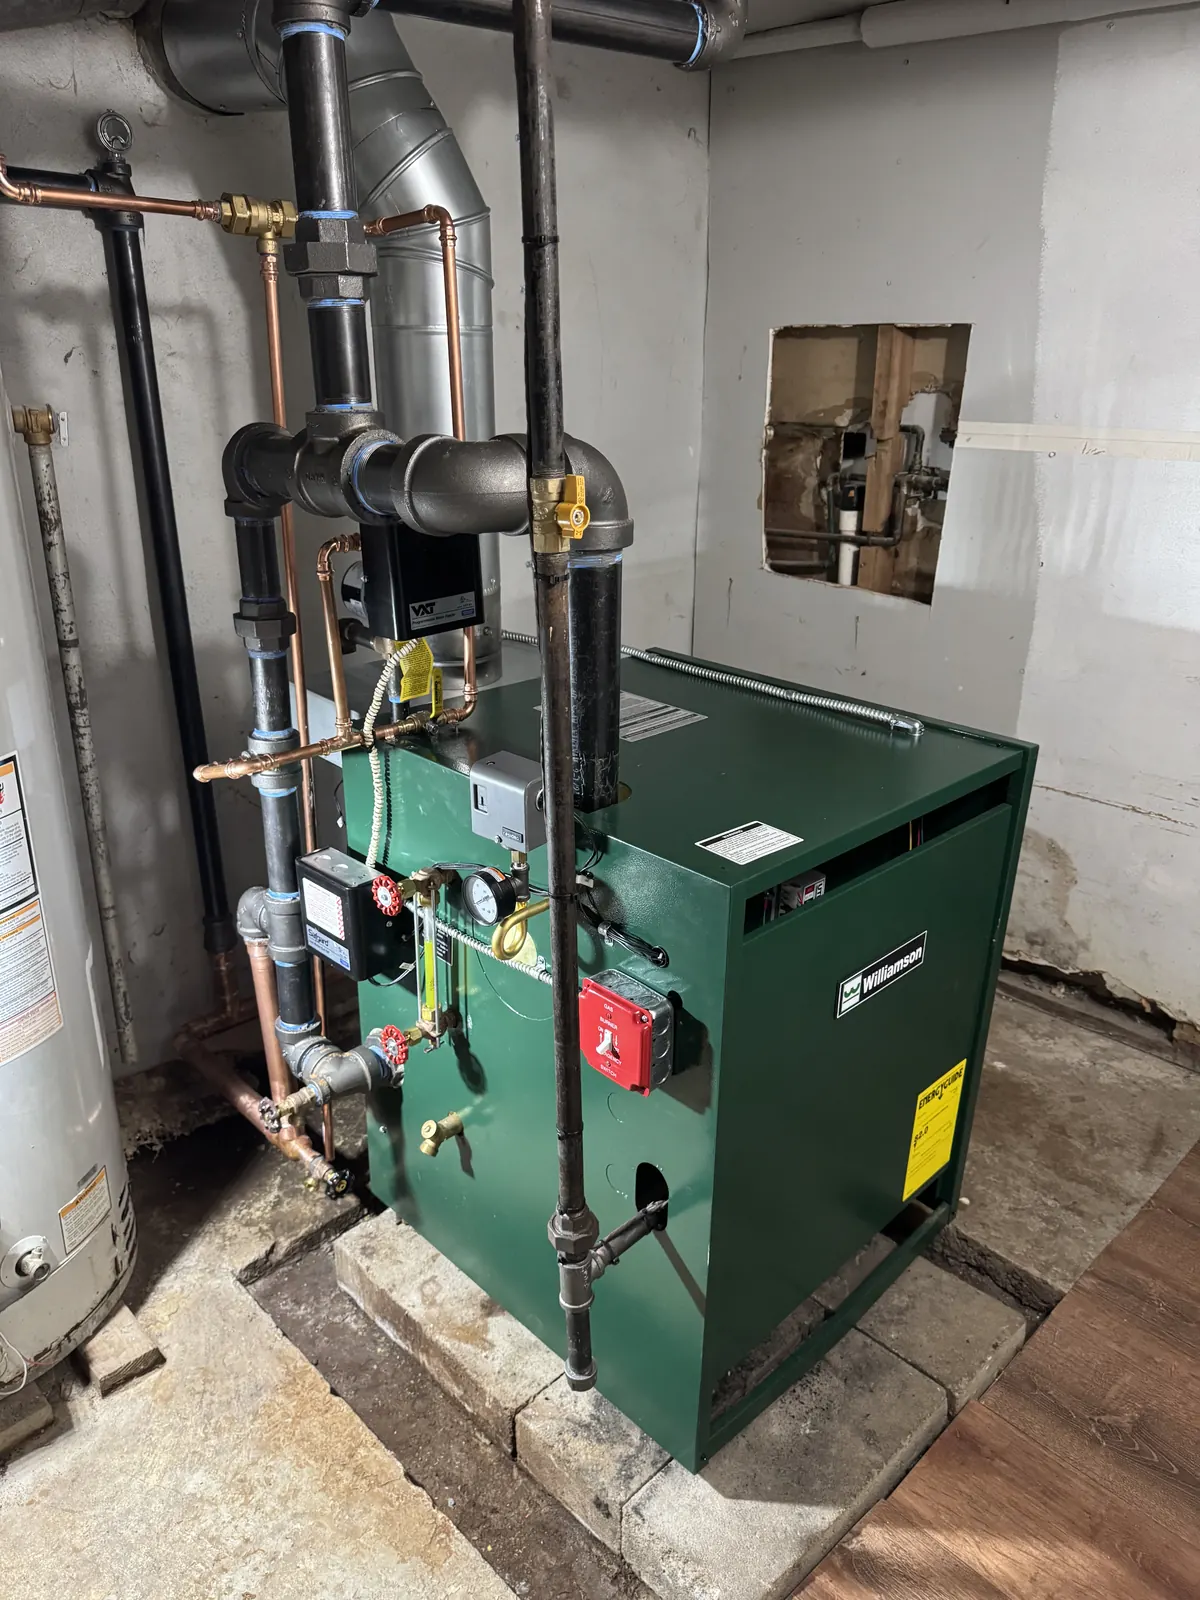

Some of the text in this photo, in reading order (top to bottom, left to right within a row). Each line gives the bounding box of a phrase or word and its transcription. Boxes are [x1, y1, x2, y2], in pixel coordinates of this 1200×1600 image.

[863, 946, 922, 994] Williamson
[604, 1003, 614, 1012] GAS
[600, 1016, 618, 1030] BURNER
[600, 1064, 617, 1078] SWITCH
[919, 1067, 964, 1110] ENERGYGUIDE
